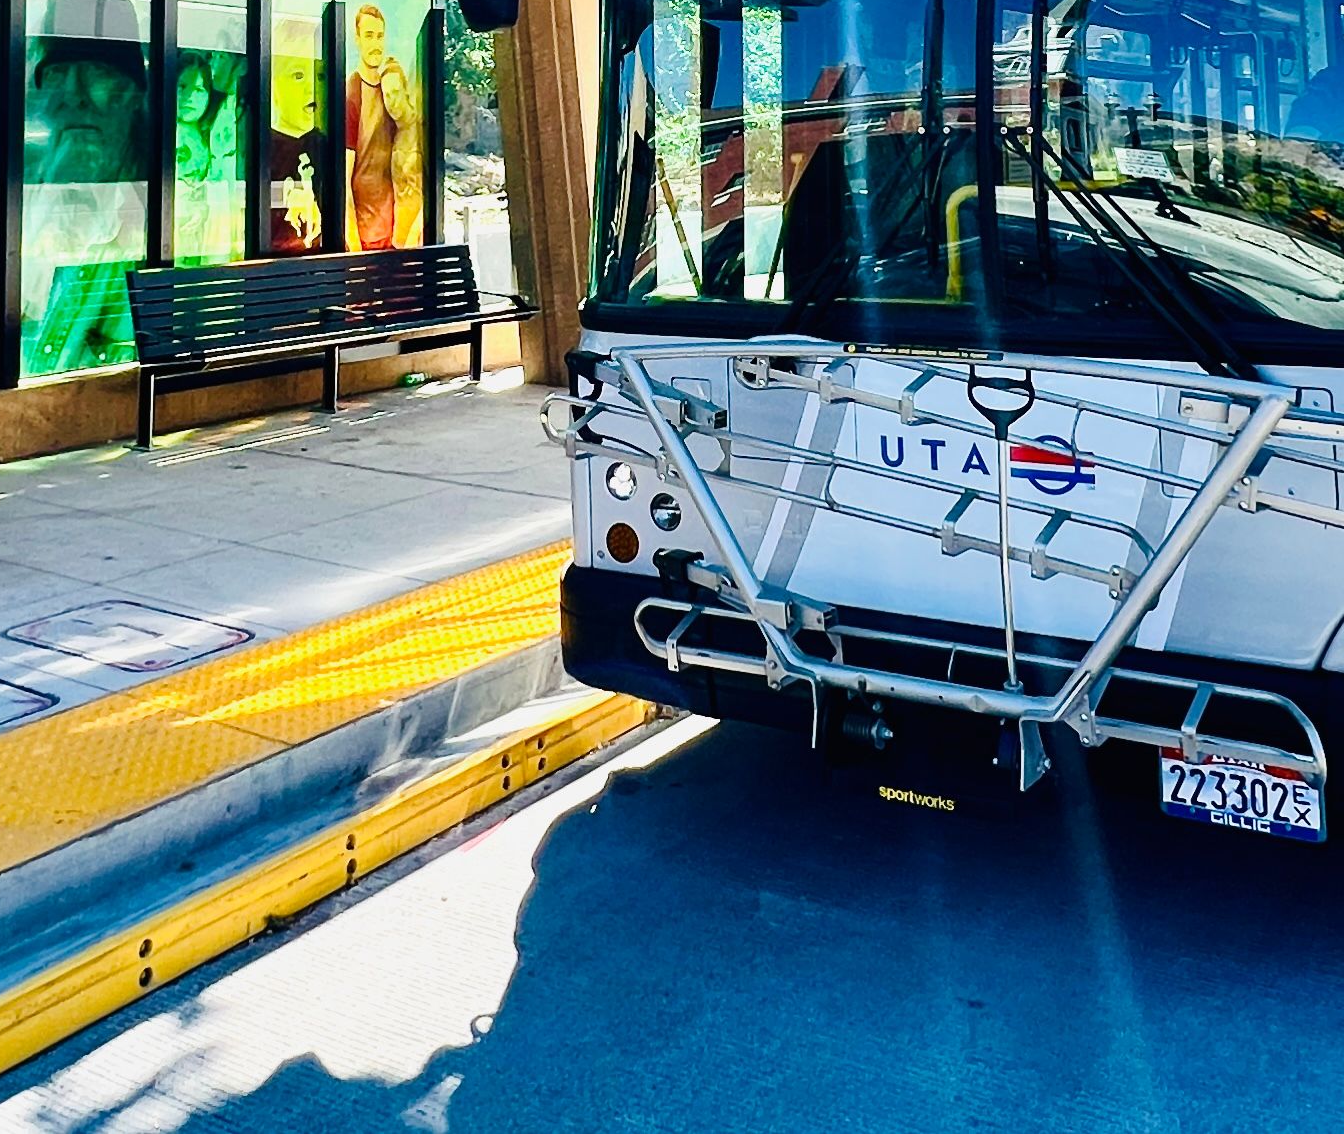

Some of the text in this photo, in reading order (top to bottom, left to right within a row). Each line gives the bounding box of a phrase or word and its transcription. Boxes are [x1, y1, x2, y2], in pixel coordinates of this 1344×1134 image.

[880, 435, 991, 476] UTA
[878, 785, 955, 811] sportworks
[1169, 764, 1291, 823] 223302
[1210, 811, 1271, 833] GILLIG
